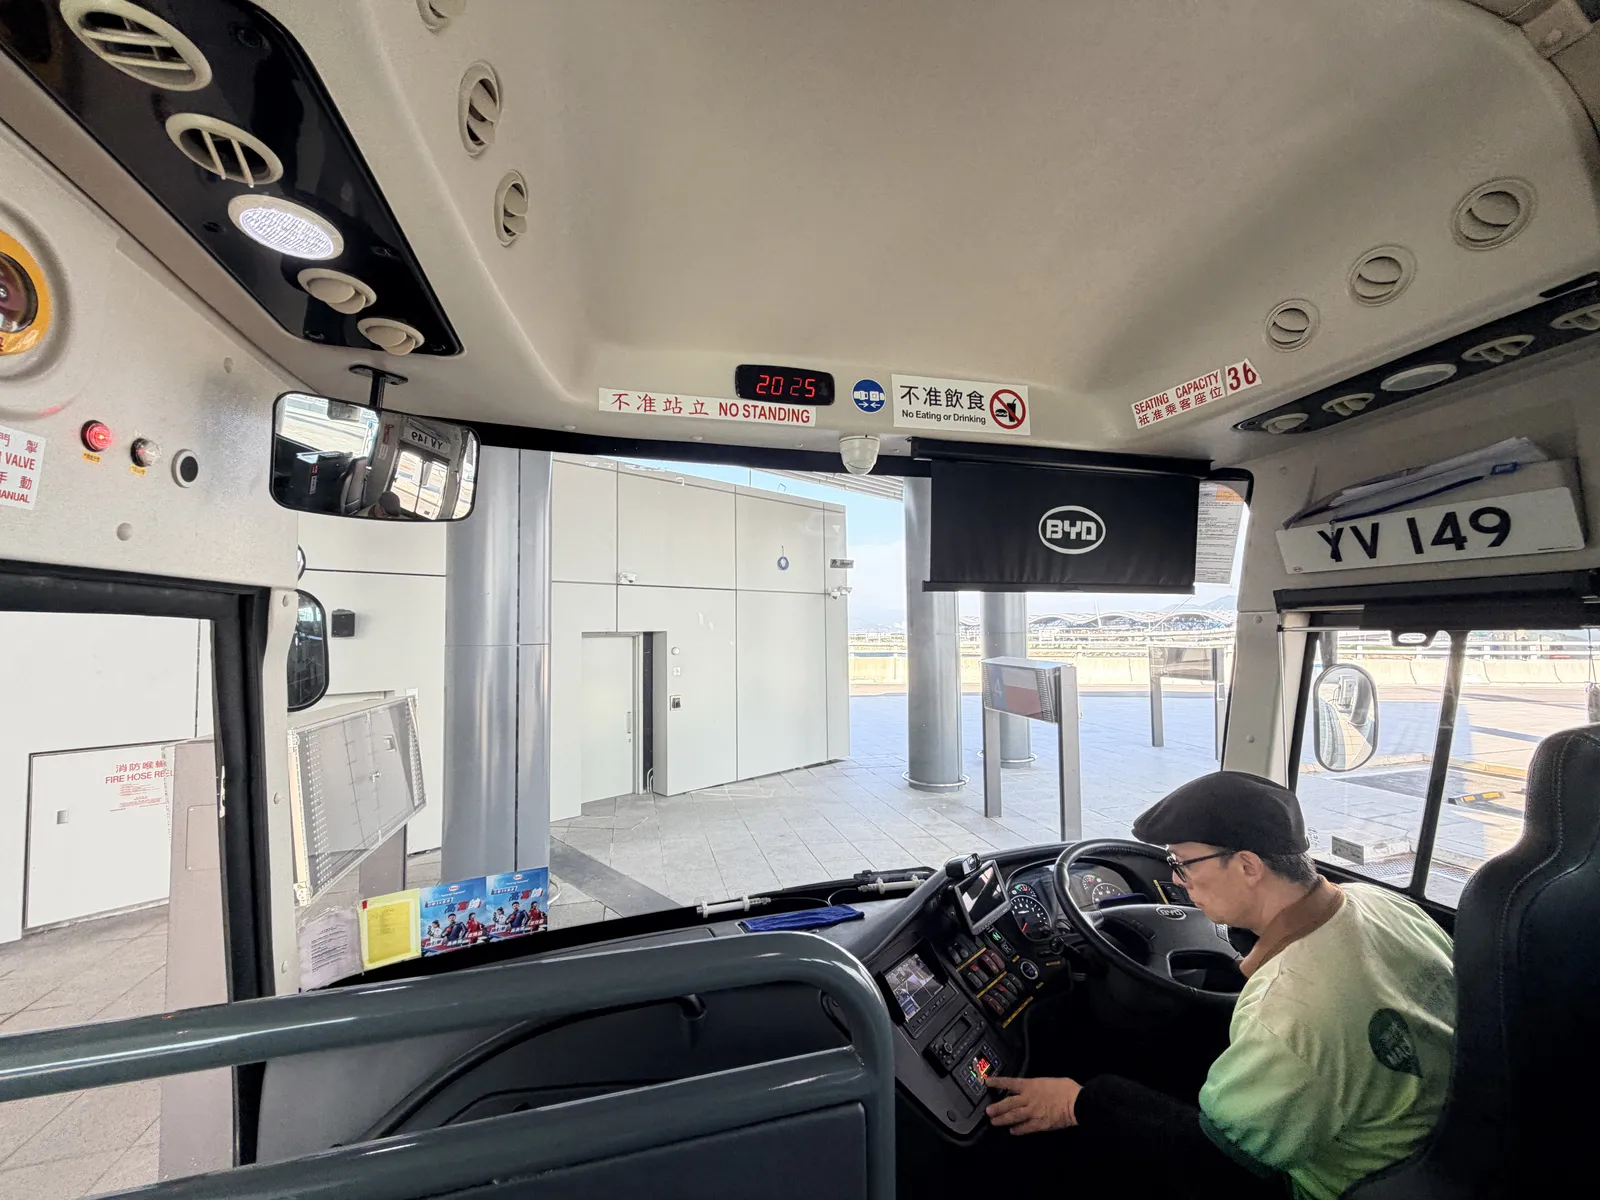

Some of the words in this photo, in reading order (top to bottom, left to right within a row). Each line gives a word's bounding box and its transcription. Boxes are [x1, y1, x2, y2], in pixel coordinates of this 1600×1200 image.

[1227, 361, 1257, 391] 36
[900, 385, 985, 411] 不准飲食
[1134, 393, 1169, 415] SEATING
[1175, 371, 1219, 399] CAPACITY
[611, 393, 709, 416] 不准站立
[719, 402, 740, 417] NO
[742, 404, 810, 424] STANDING
[902, 409, 914, 418] No
[915, 410, 941, 422] Eating
[953, 413, 986, 425] Drinking
[5, 452, 36, 471] VALVE
[0, 489, 30, 504] ANUAL
[1046, 519, 1097, 541] BYD
[1317, 522, 1379, 562] YV
[1406, 506, 1512, 555] 149
[105, 775, 125, 784] FIRE
[127, 771, 152, 781] HOSE
